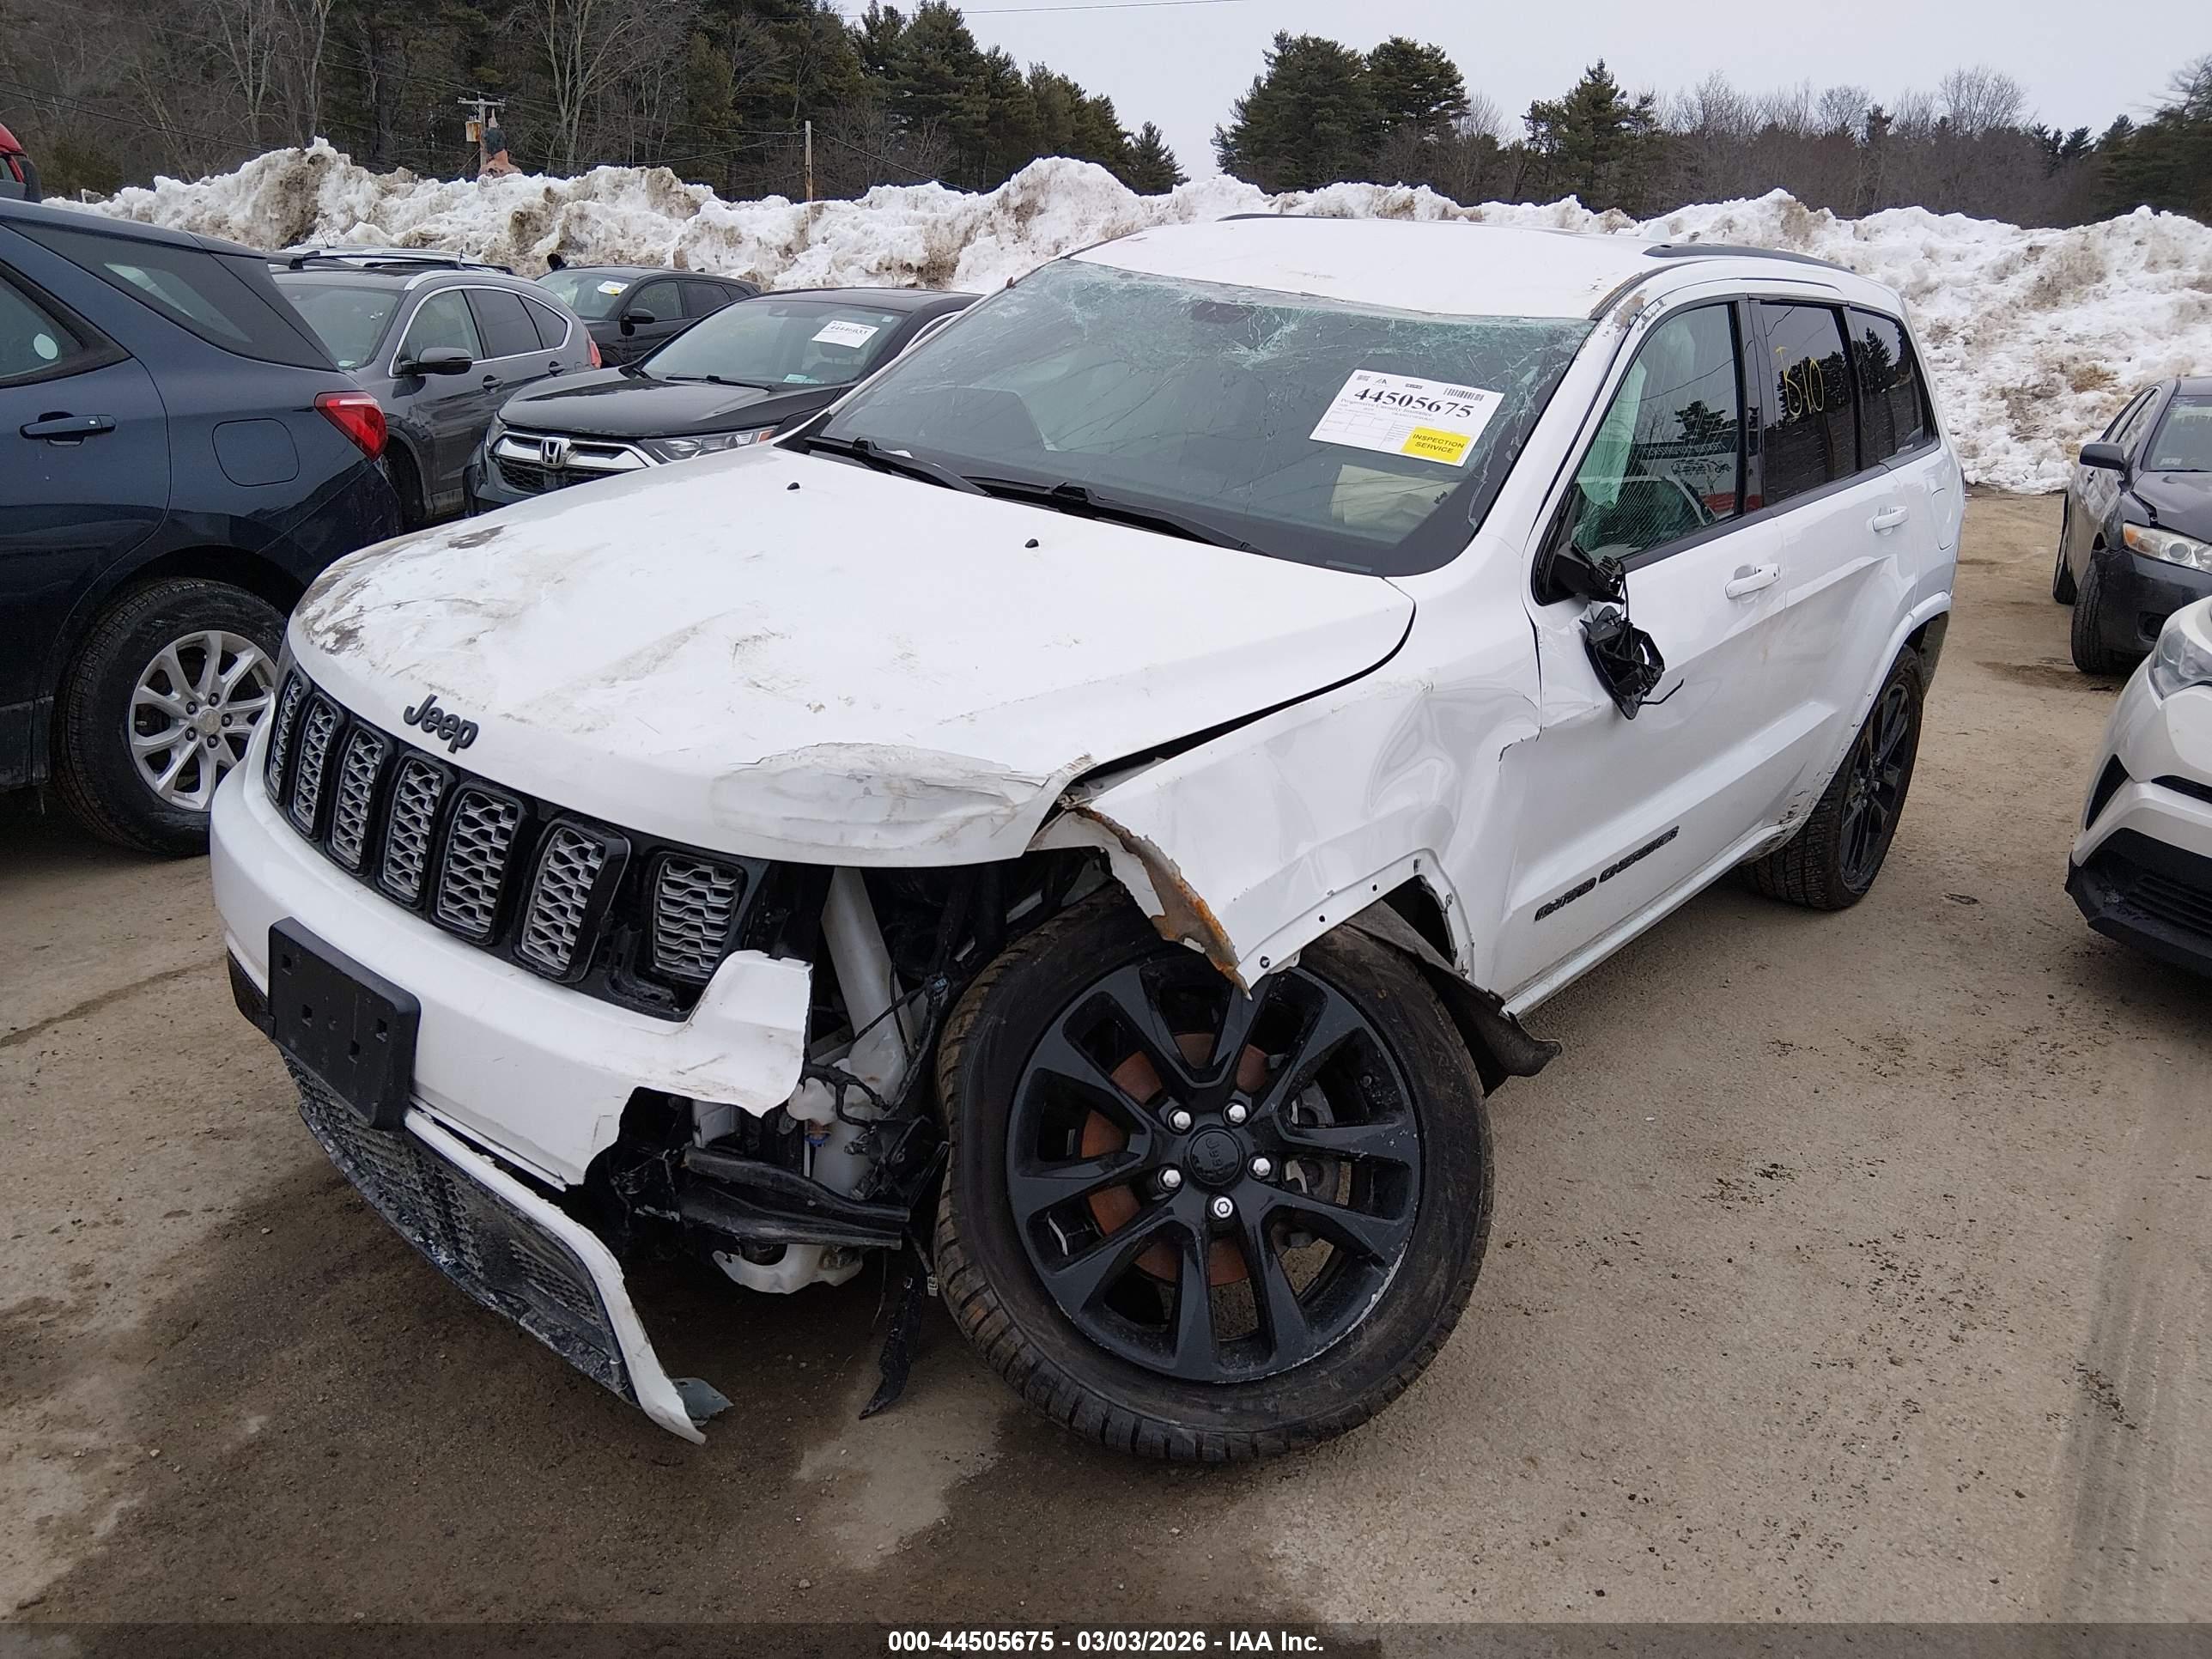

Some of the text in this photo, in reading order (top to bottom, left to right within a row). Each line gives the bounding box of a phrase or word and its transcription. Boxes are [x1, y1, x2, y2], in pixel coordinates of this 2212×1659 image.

[1354, 387, 1474, 418] 44505675
[1413, 434, 1465, 449] INSPECTION
[1415, 441, 1454, 453] SERVICE
[404, 694, 478, 754] Jeep
